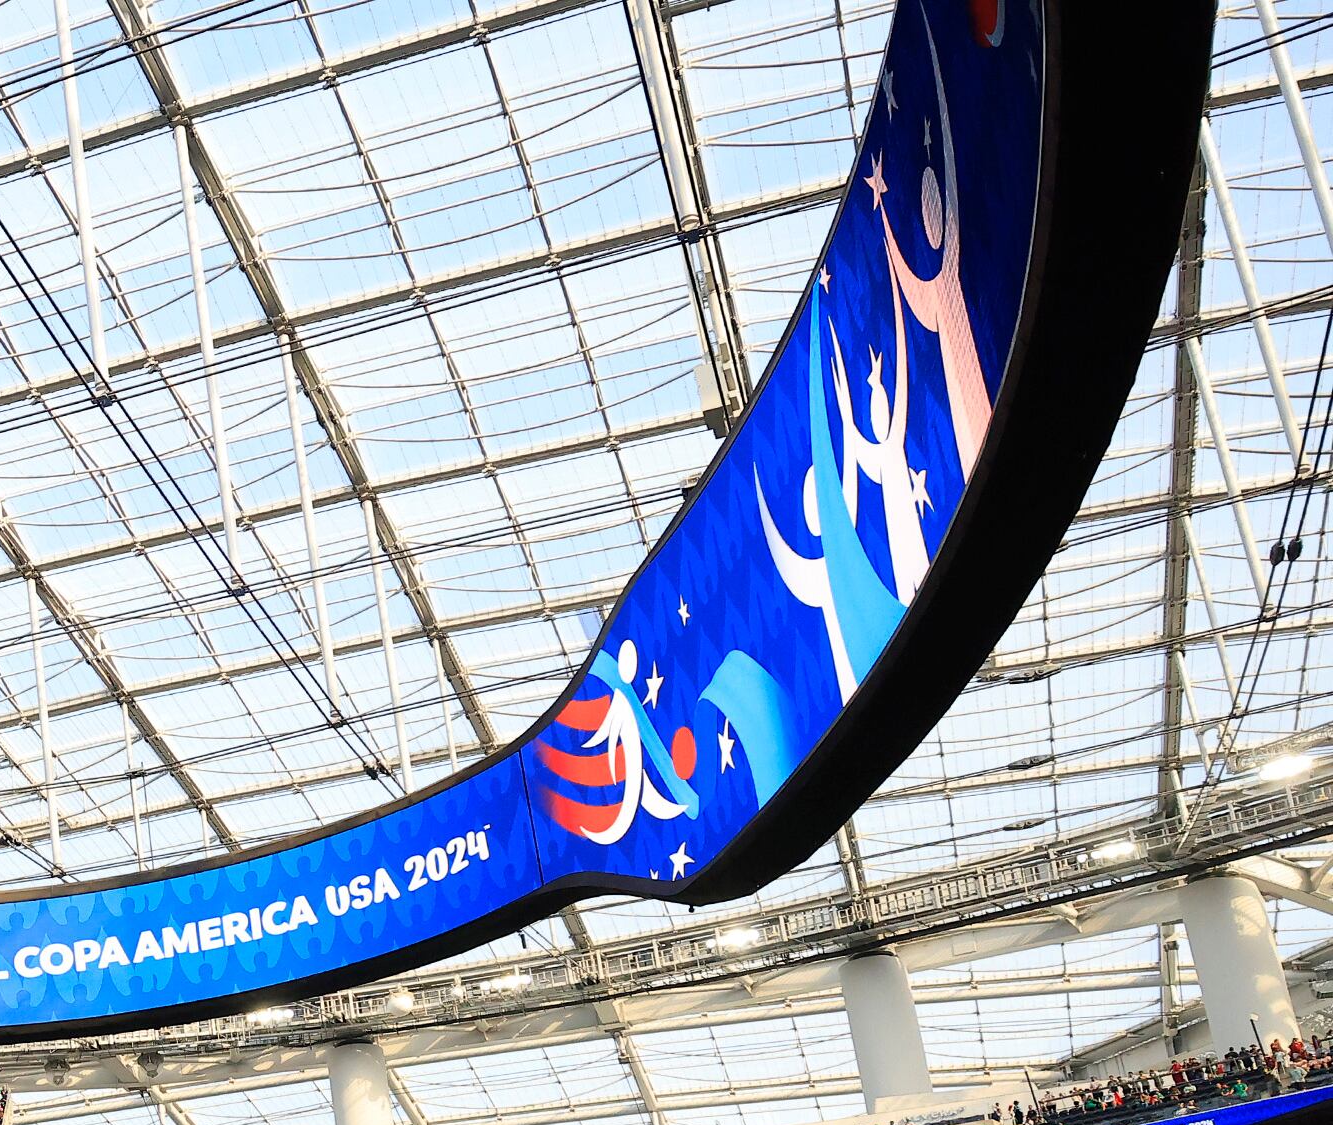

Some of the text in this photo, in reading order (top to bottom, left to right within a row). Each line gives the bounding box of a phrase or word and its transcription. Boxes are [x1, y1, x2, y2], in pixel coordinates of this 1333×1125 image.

[14, 936, 130, 978] COPA
[133, 895, 318, 964] AMERICA
[325, 868, 400, 916] USA
[404, 829, 490, 893] 2024
